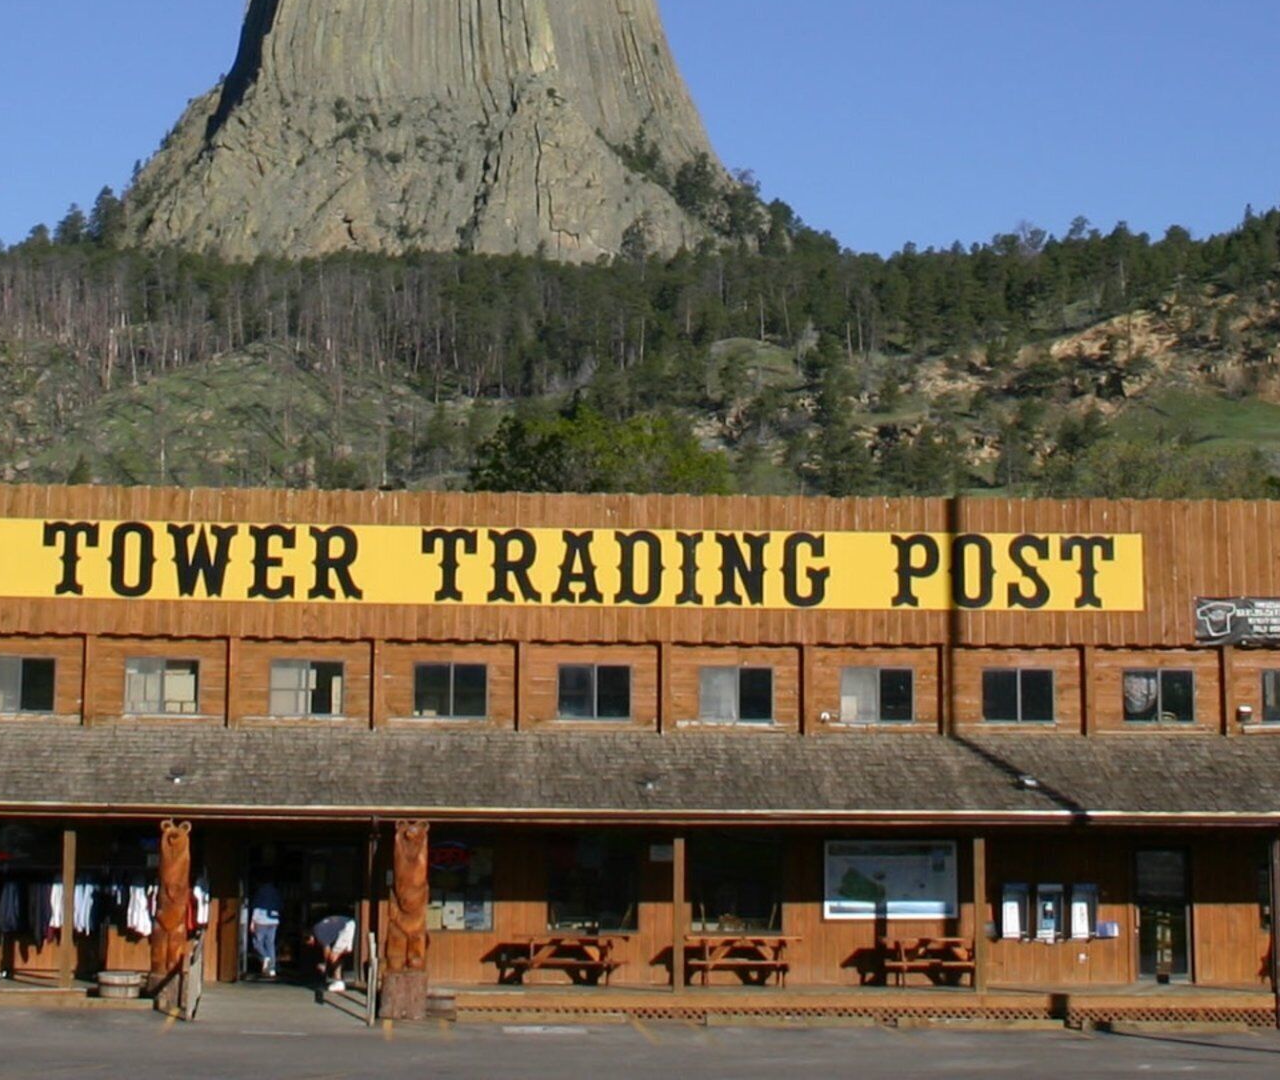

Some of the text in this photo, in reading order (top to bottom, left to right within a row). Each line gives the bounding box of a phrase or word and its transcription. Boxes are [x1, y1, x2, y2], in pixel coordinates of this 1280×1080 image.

[43, 520, 363, 602] TOWER
[421, 528, 830, 607] TRADING
[891, 533, 1115, 609] POST
